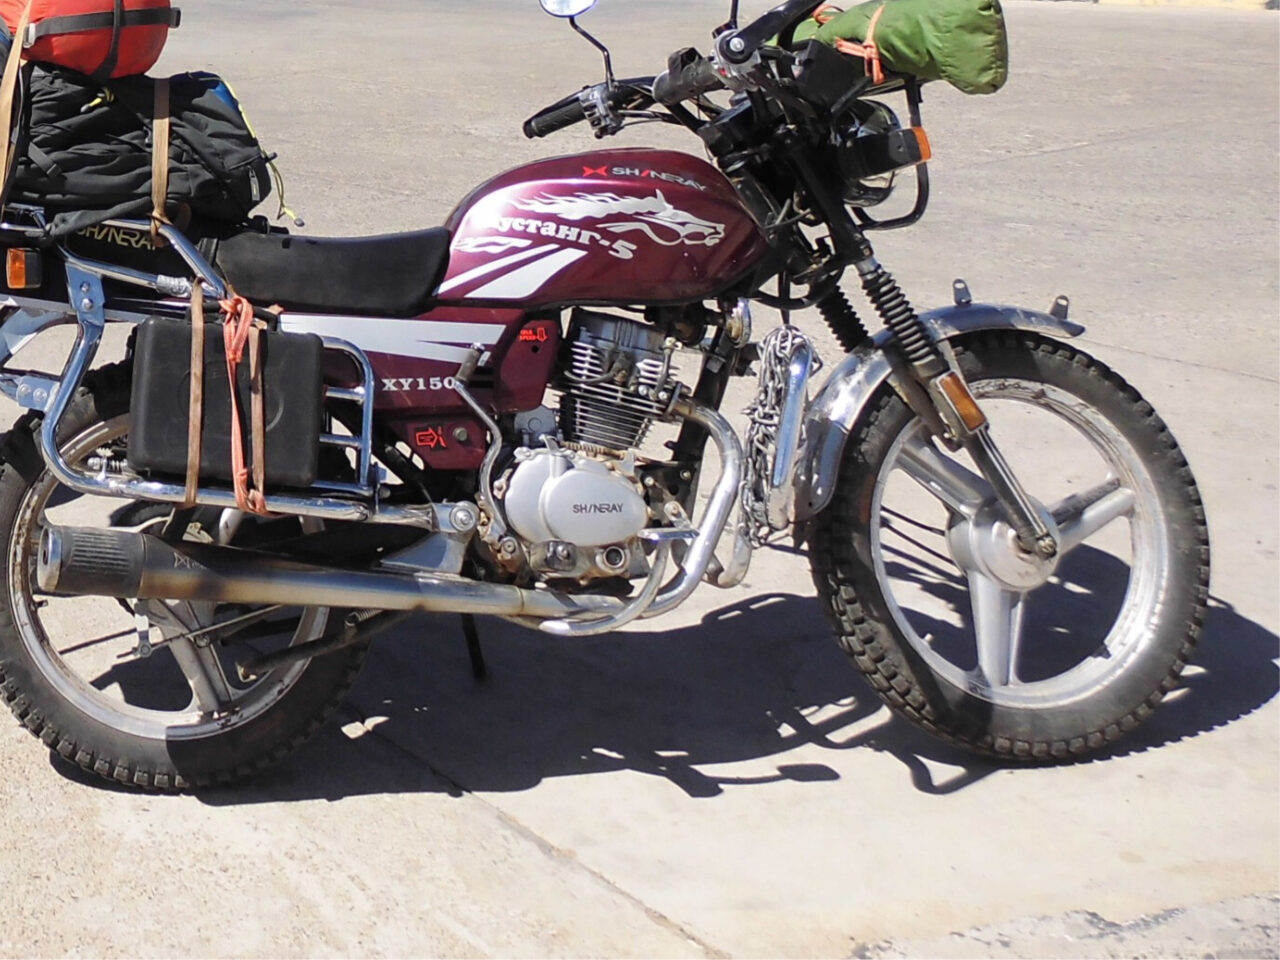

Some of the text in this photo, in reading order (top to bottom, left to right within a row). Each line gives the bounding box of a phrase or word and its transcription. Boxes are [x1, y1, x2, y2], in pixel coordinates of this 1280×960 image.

[612, 167, 707, 191] SHINERAY
[77, 225, 157, 251] HINERA
[381, 376, 456, 391] XY150
[572, 503, 624, 514] SHINERAY
